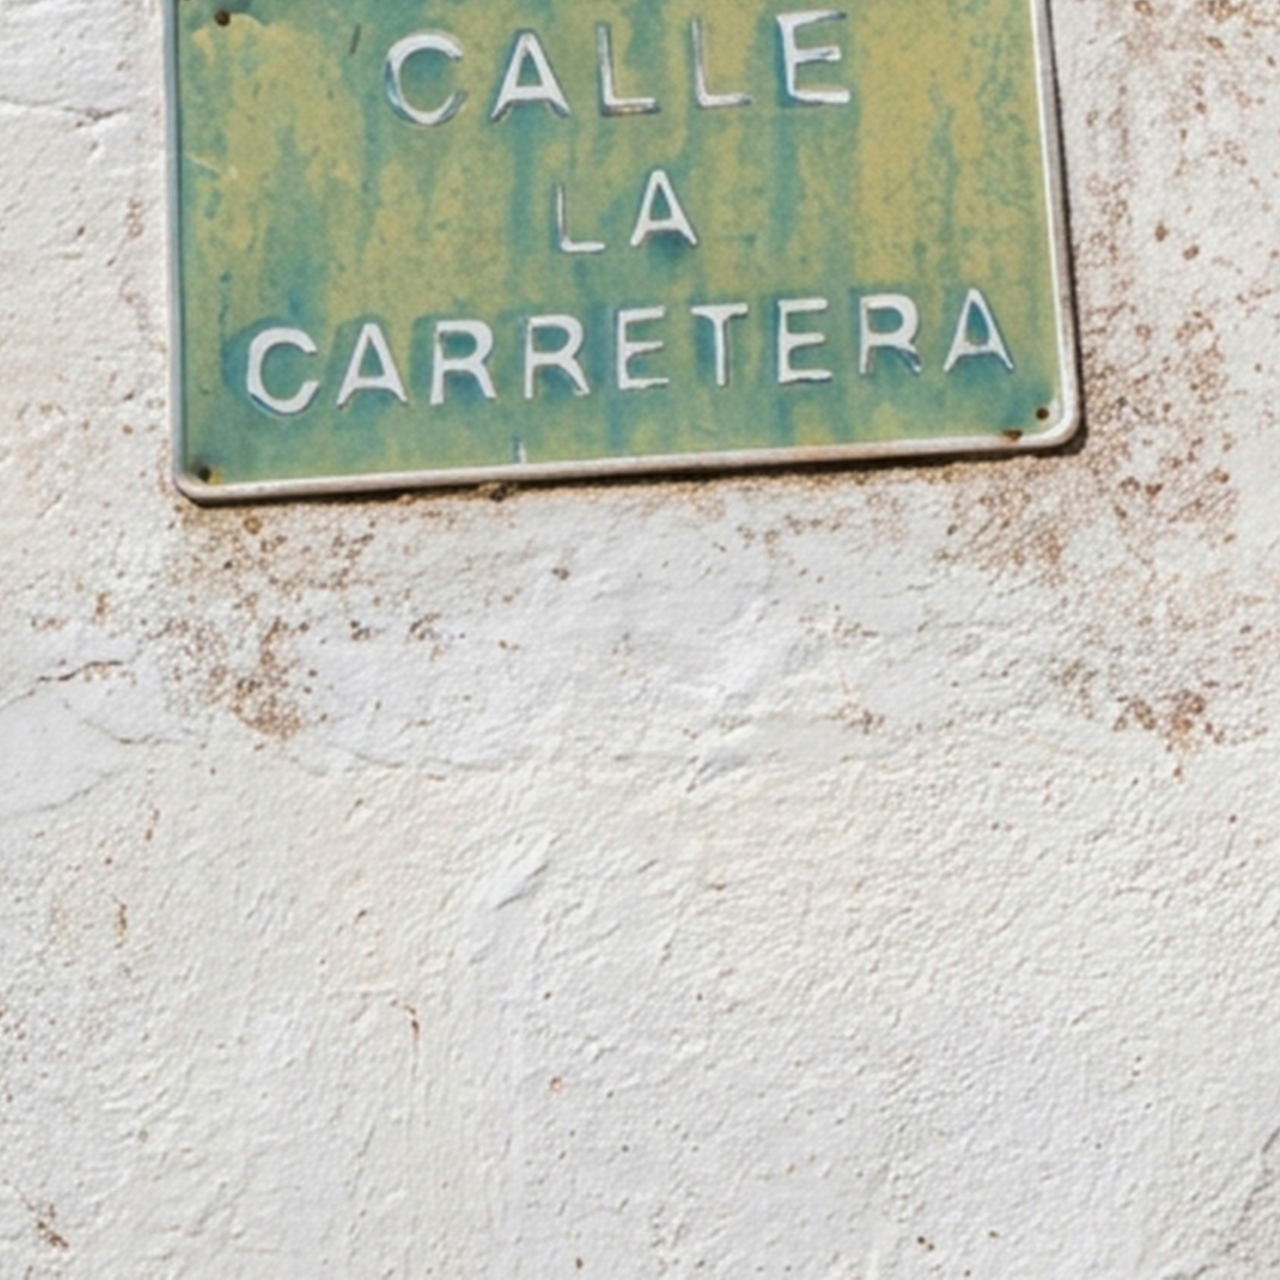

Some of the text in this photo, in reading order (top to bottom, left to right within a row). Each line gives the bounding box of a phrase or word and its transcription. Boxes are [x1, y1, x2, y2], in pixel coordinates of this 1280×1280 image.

[384, 9, 852, 124] CALLE
[555, 169, 697, 253] LA
[244, 287, 1014, 415] CARRETERA
